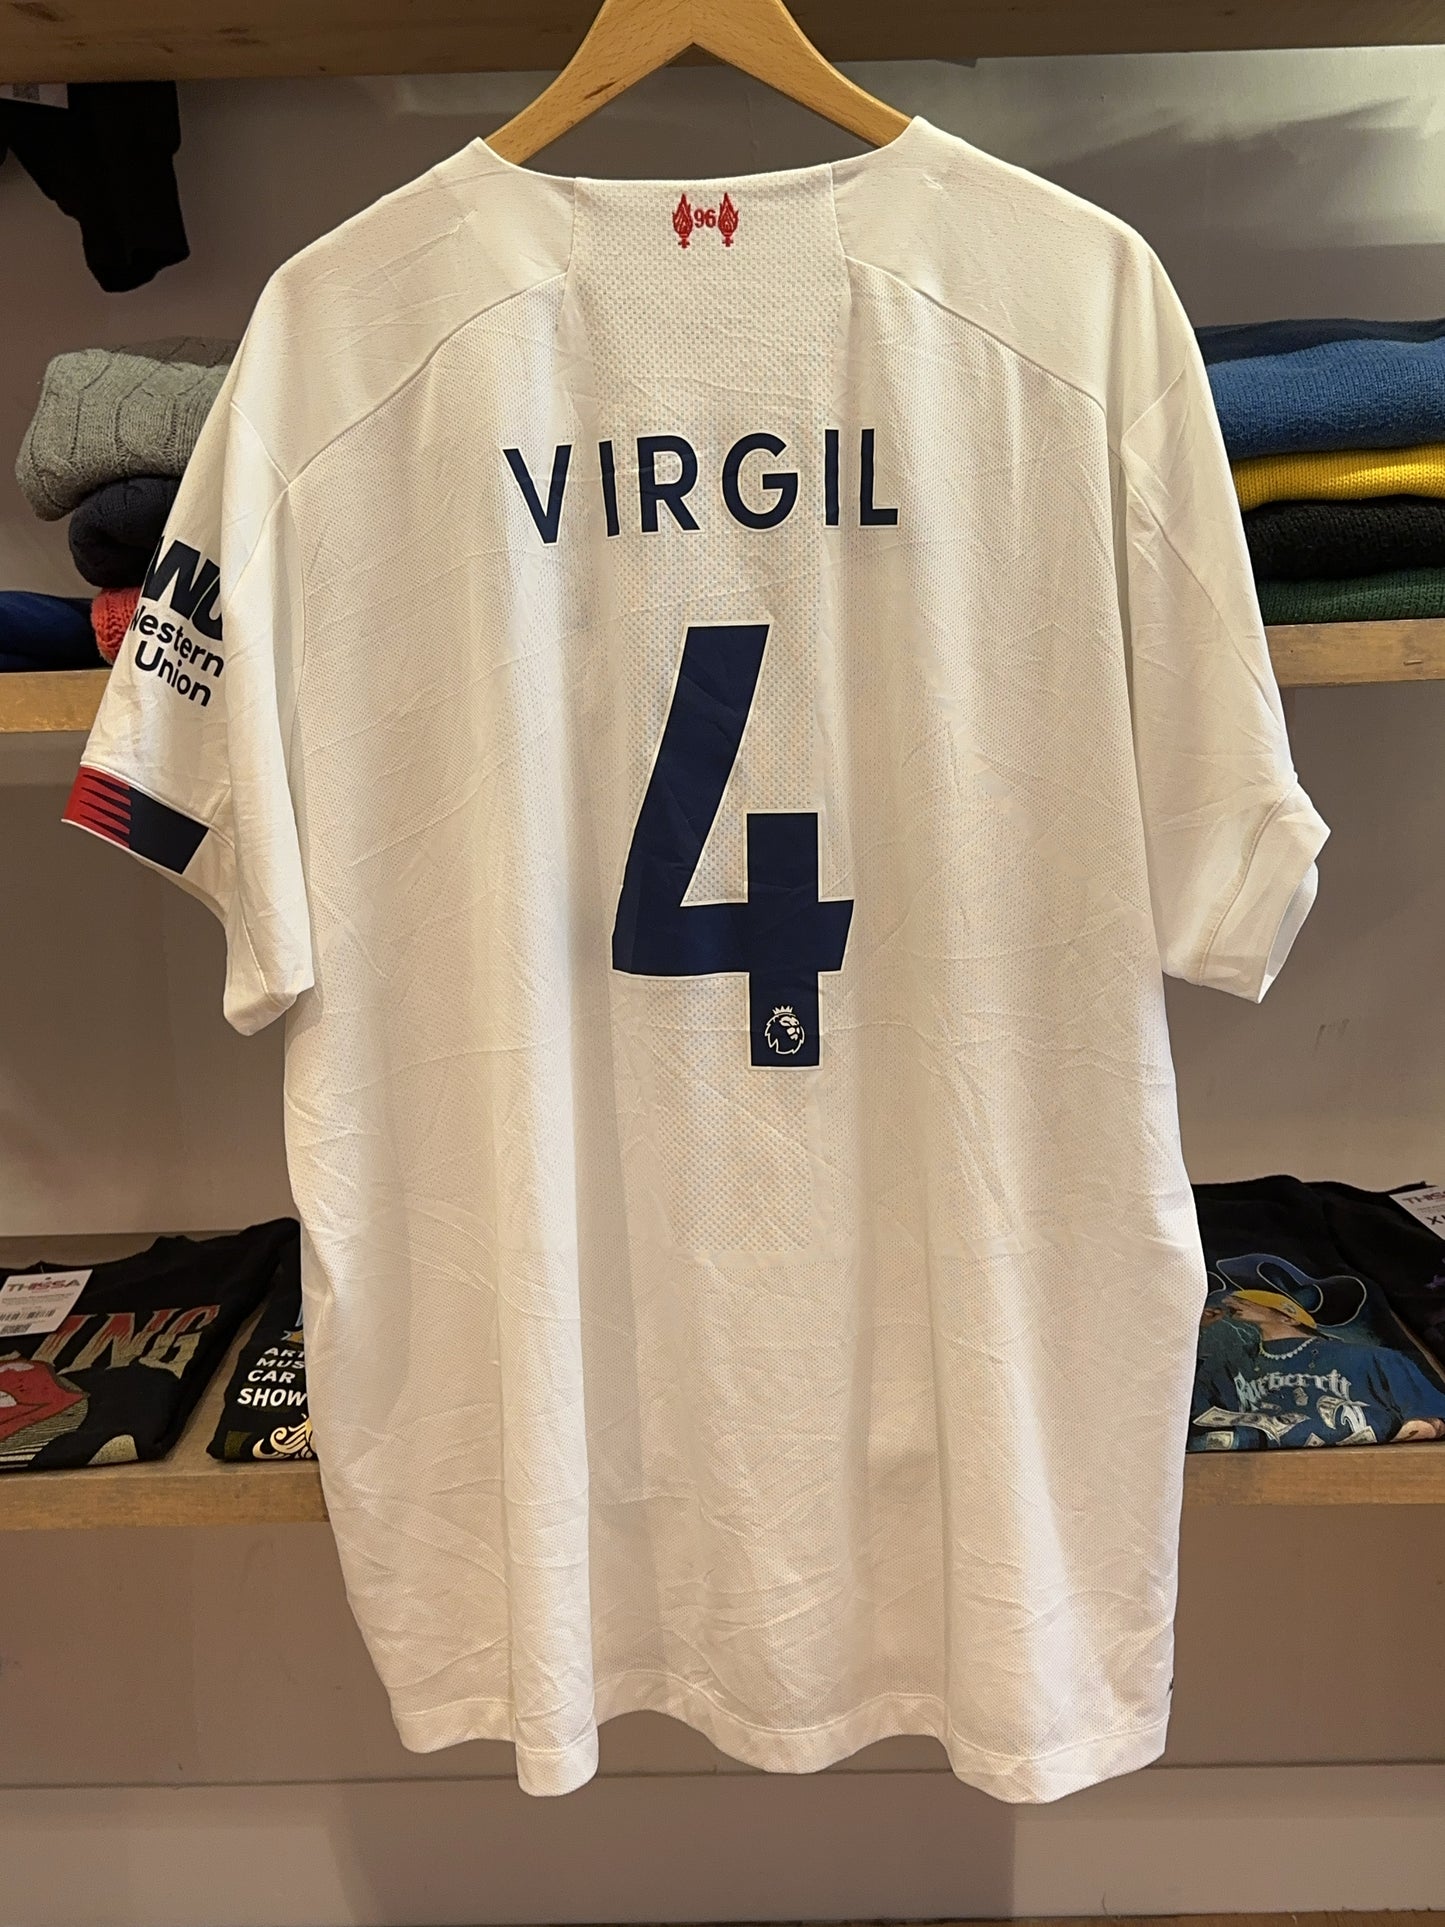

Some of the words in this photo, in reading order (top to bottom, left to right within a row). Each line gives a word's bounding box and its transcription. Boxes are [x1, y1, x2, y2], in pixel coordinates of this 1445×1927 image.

[693, 208, 717, 229] 96
[502, 427, 899, 545] VIRGIL
[134, 640, 211, 707] Union
[611, 623, 855, 1067] 4
[236, 1387, 308, 1407] SHOW
[247, 1369, 296, 1384] CAR
